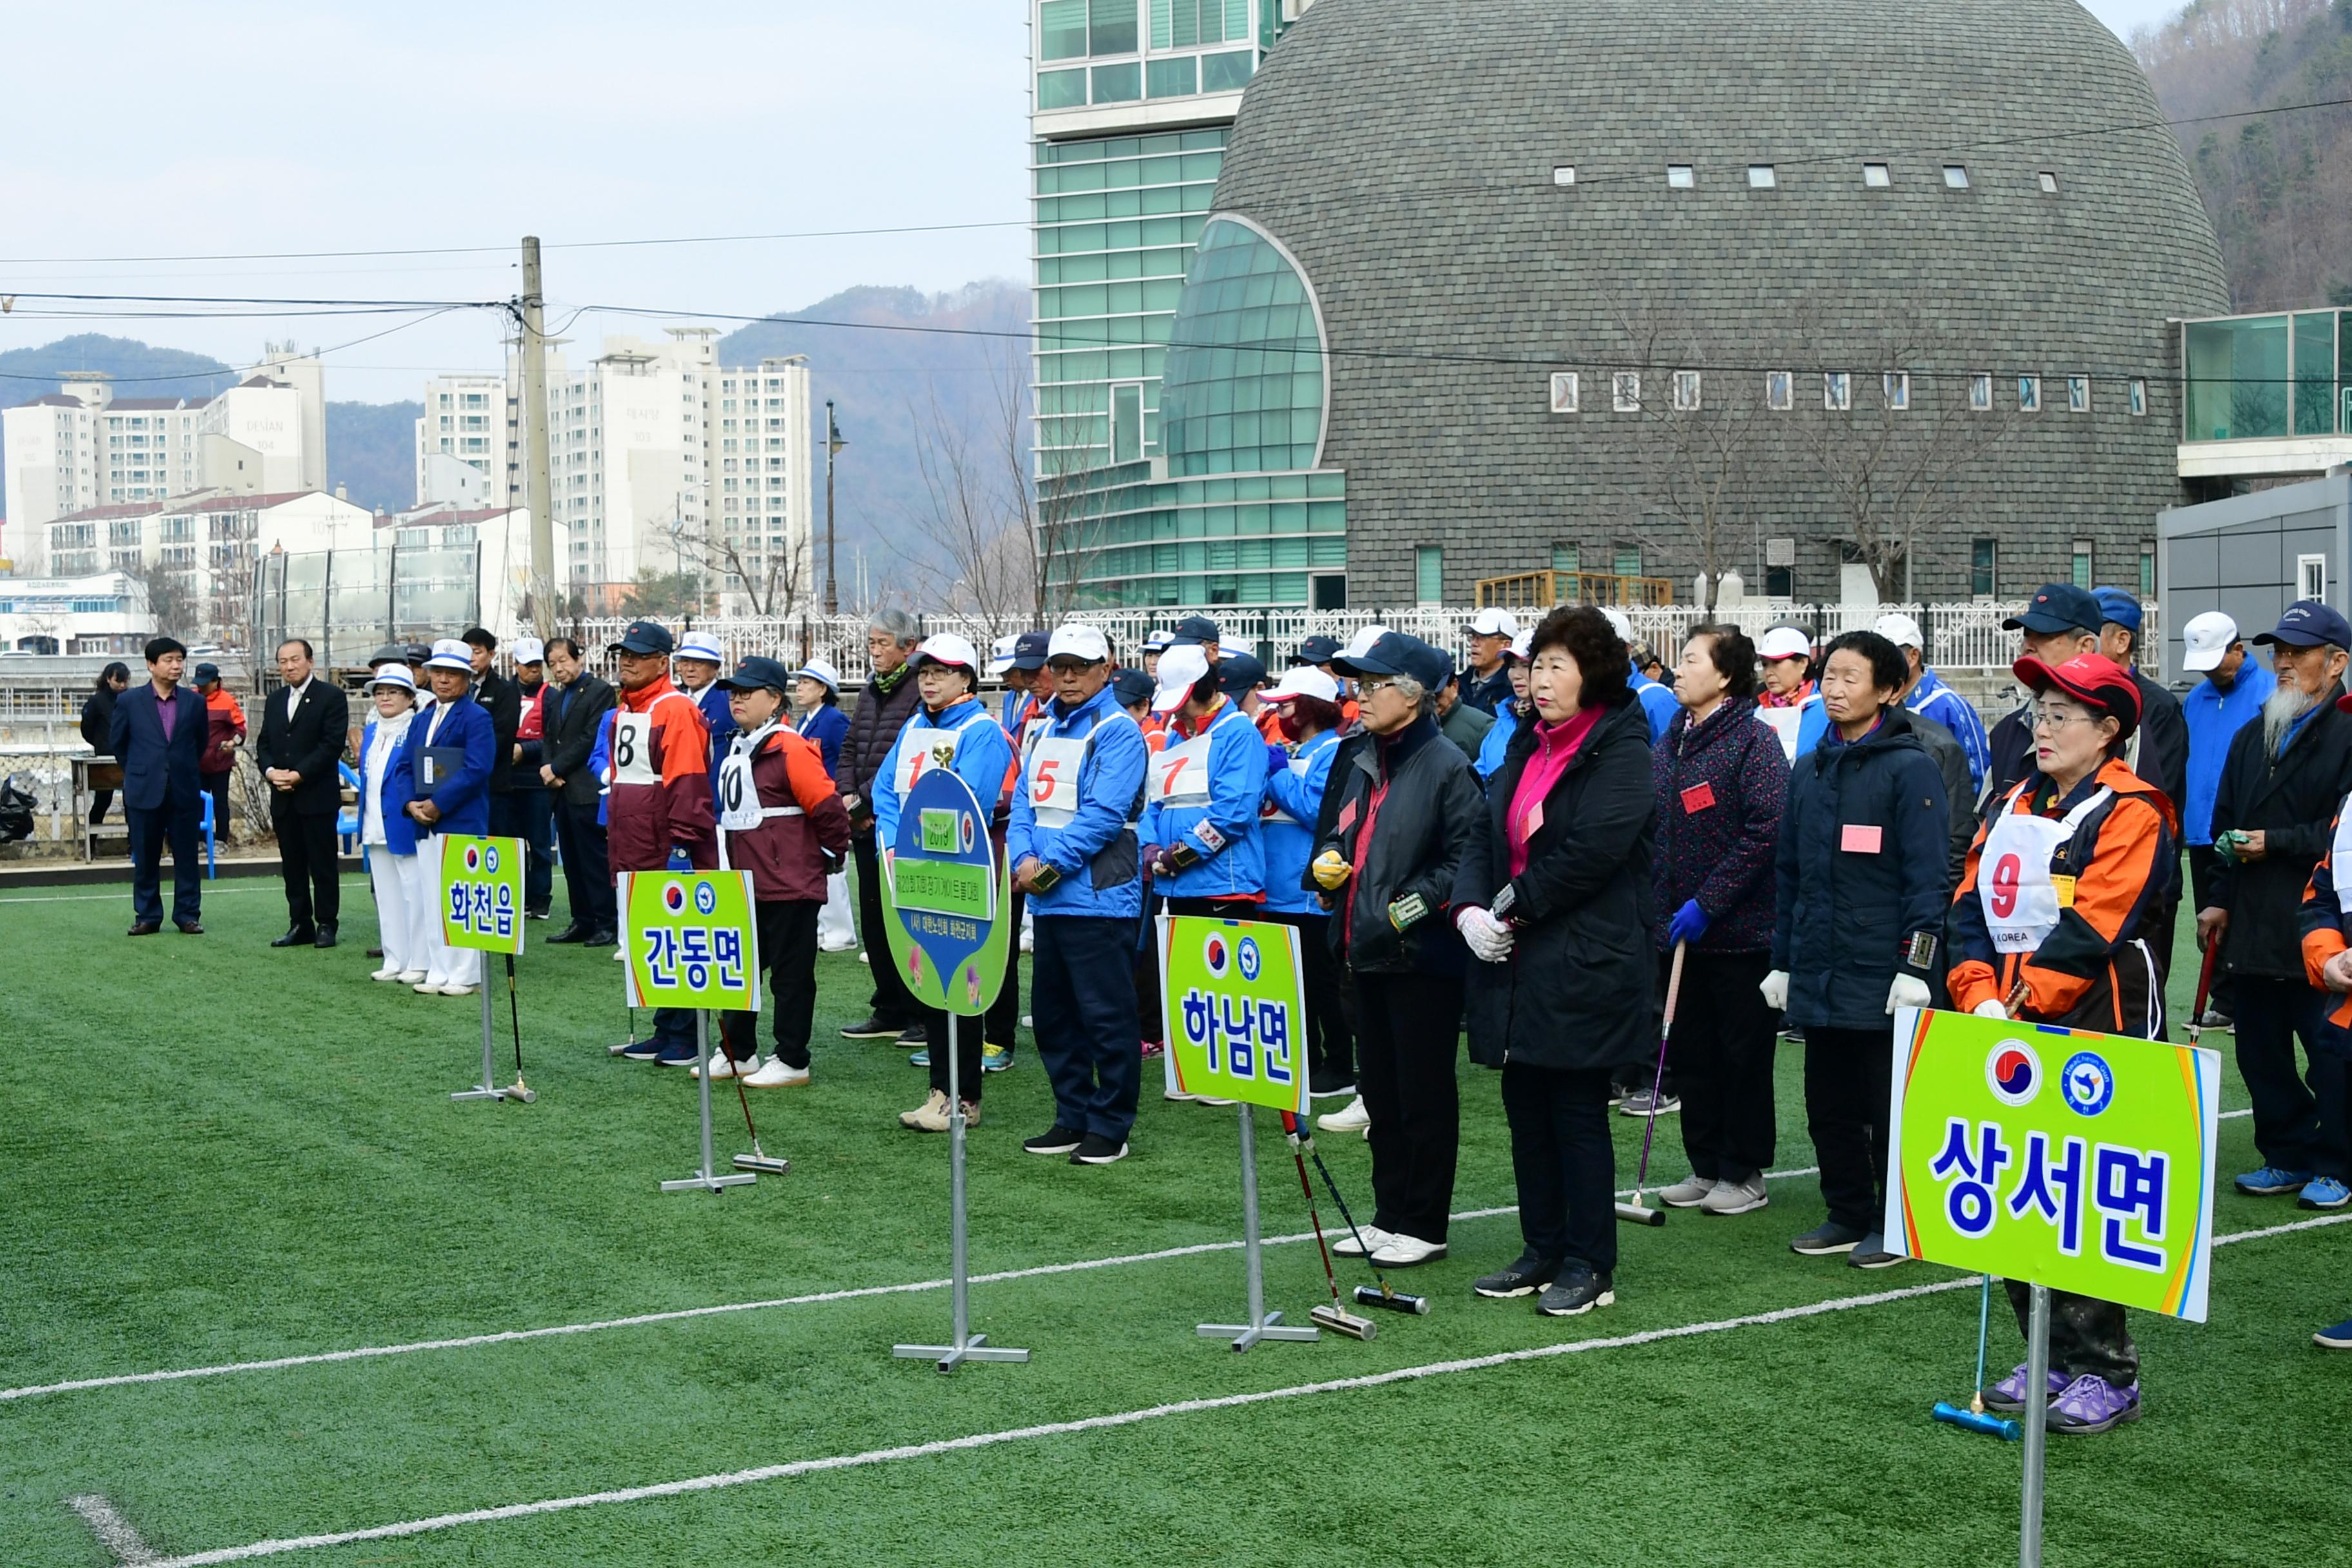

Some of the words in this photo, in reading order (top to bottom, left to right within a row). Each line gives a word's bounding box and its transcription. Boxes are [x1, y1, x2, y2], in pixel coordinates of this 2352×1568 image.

[519, 700, 534, 729] 7
[618, 725, 636, 767] 8
[721, 765, 743, 812] 10
[909, 751, 926, 790] 1
[1034, 760, 1060, 802] 5
[1161, 756, 1190, 796] 7
[929, 823, 949, 847] 2019
[1991, 852, 2021, 919] 9
[450, 881, 514, 937] 화천읍
[923, 915, 948, 936] 대한노인회
[645, 928, 743, 989] 간동면
[1997, 932, 2028, 943] KOREA
[1182, 990, 1291, 1082] 하남면
[2064, 1055, 2099, 1076] HwaCheon
[2099, 1064, 2110, 1083] Gun
[1931, 1121, 2166, 1268] 상서면
